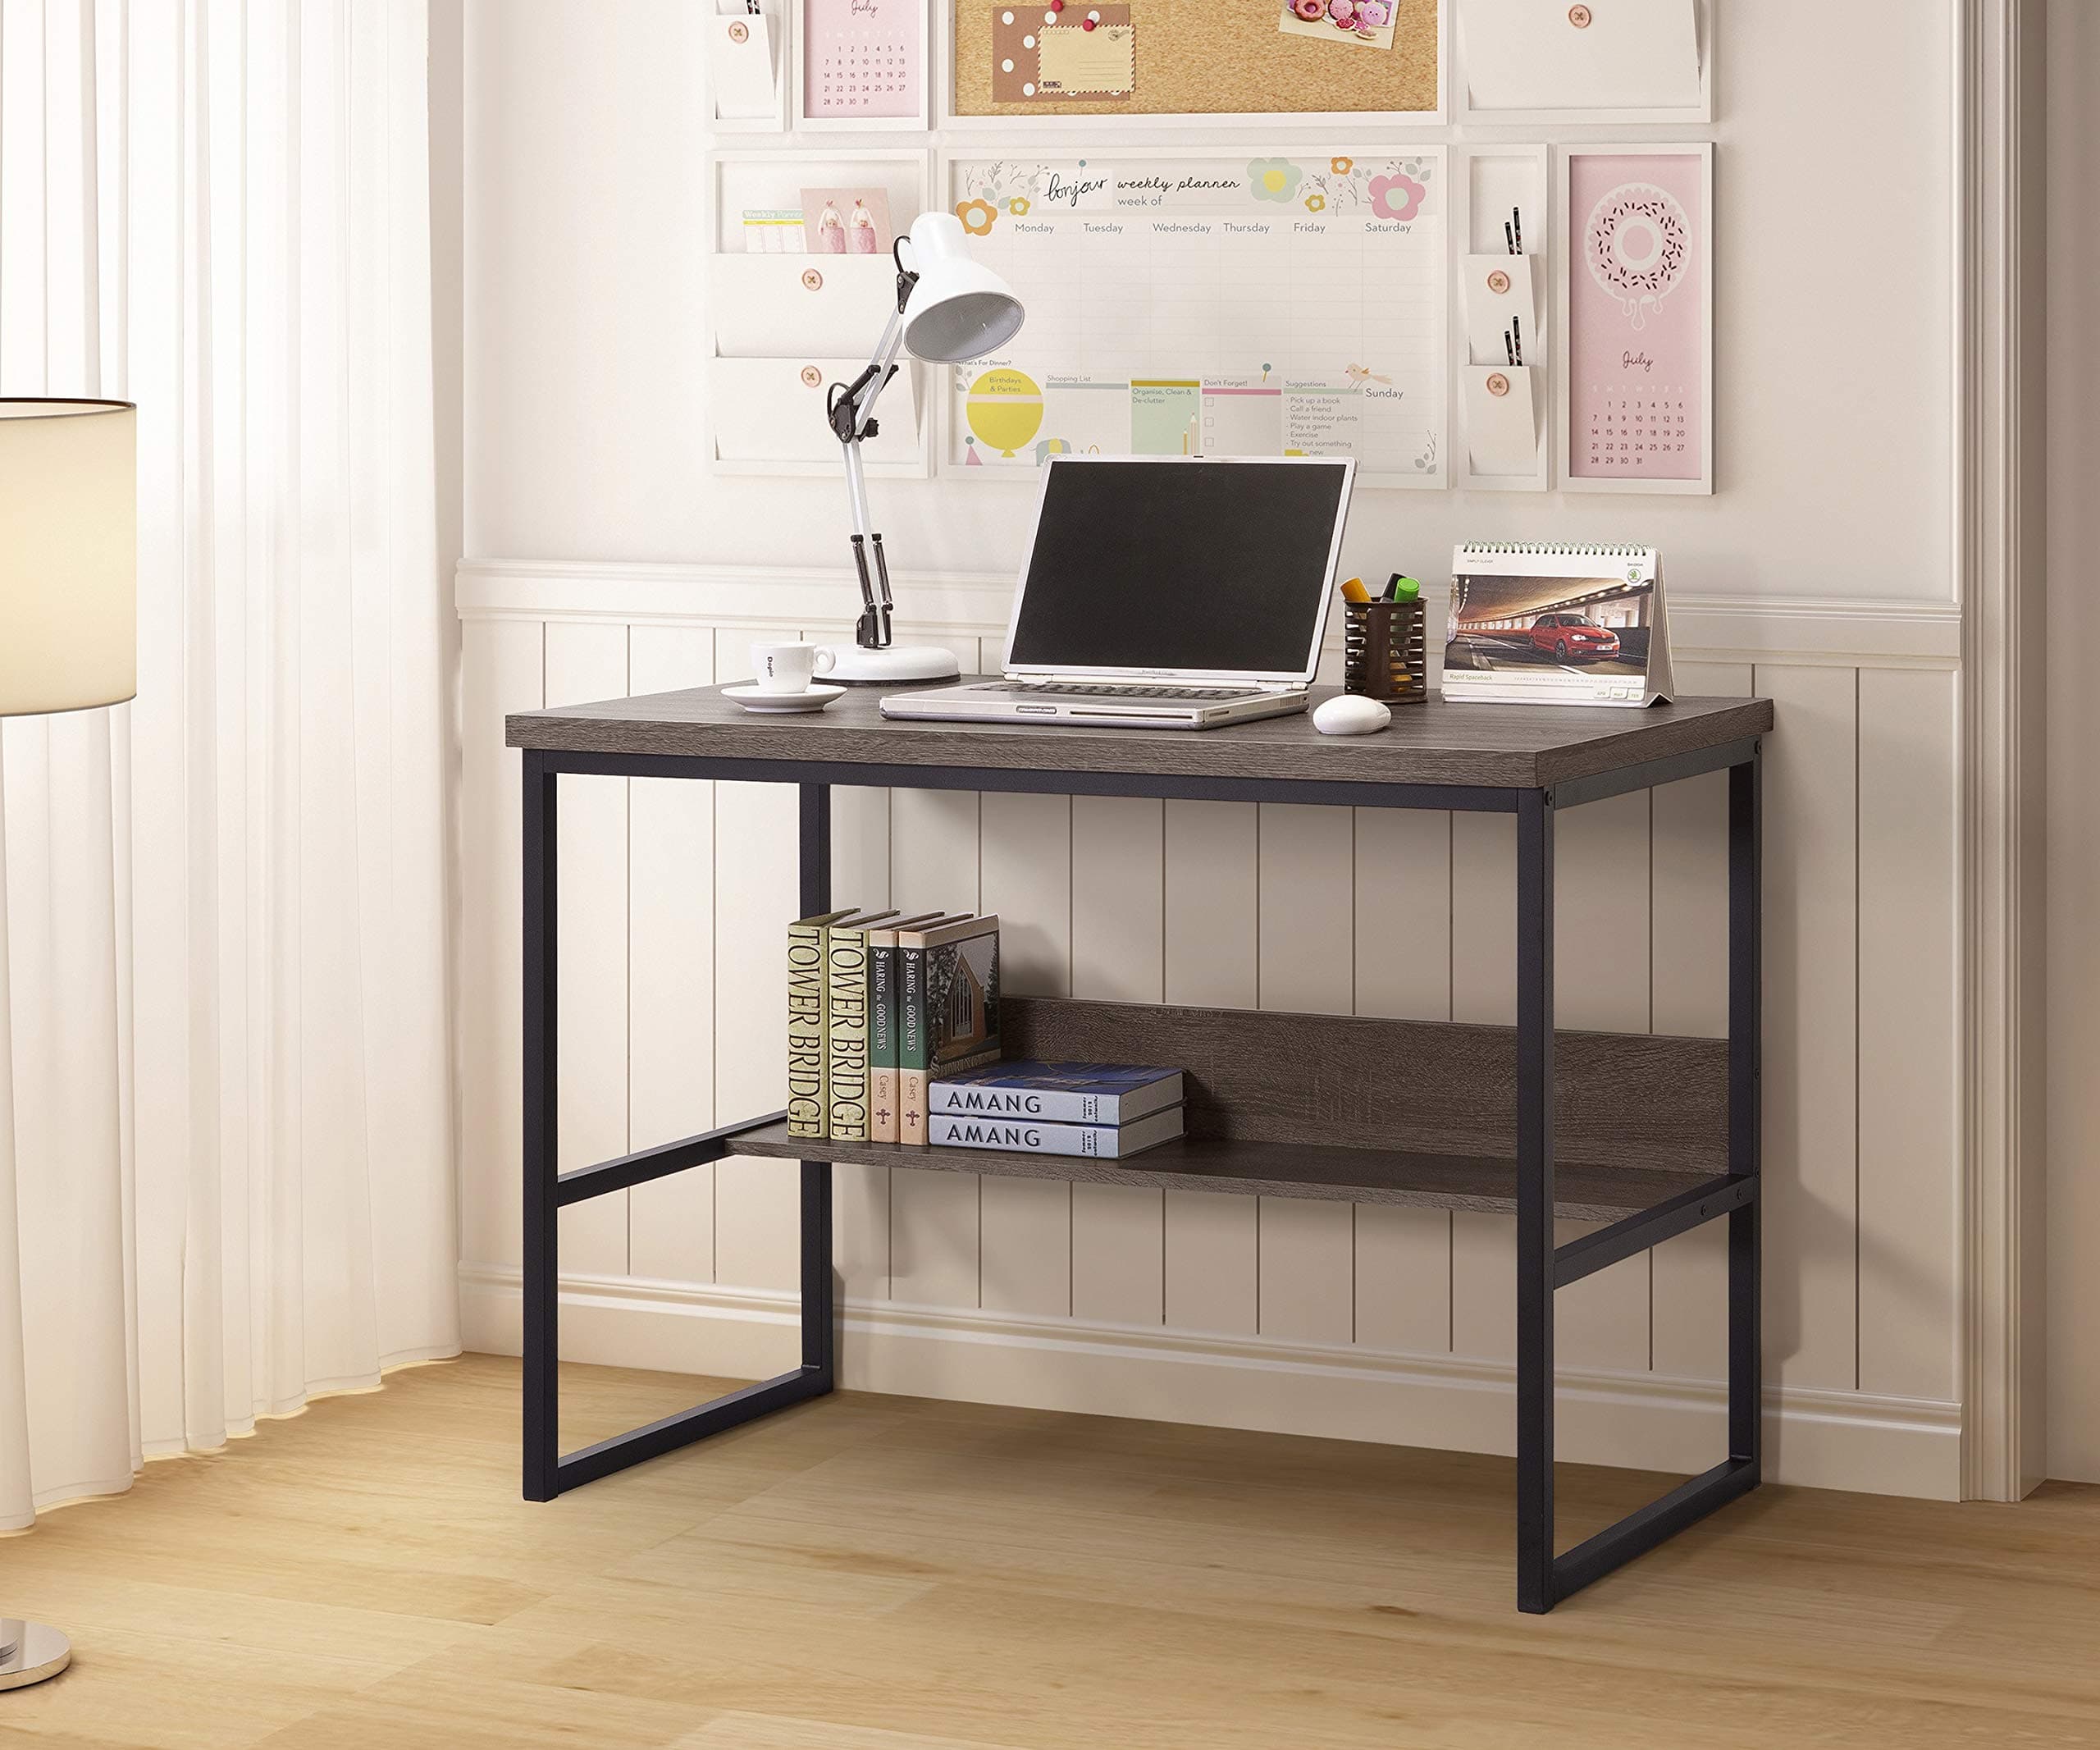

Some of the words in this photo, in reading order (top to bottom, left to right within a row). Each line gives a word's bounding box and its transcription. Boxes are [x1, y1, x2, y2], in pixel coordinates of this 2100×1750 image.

[851, 0, 878, 18] July
[1117, 176, 1173, 192] weekly
[1176, 177, 1241, 192] planner
[1117, 195, 1148, 206] week
[1149, 195, 1162, 206] of
[1015, 223, 1055, 235] Monday
[1084, 223, 1124, 235] Tuesday
[1153, 223, 1212, 235] Wednesday
[1223, 223, 1271, 235] Thursday
[1294, 223, 1326, 235] Friday
[1365, 223, 1412, 235] Saturday
[1623, 350, 1654, 372] July
[989, 377, 1021, 385] Birthdays
[1048, 375, 1078, 383] Shopping
[1285, 380, 1326, 388] Suggestions
[1366, 388, 1404, 400] Sunday
[1622, 400, 1627, 409] 2
[1664, 401, 1669, 409] 5
[1635, 414, 1643, 423] 10
[1663, 415, 1670, 423] 12
[1290, 423, 1304, 431] Play
[1606, 428, 1614, 436] 15
[1620, 428, 1628, 436] 16
[1636, 428, 1642, 436] 17
[1291, 440, 1300, 448] Try
[1316, 441, 1352, 449] something
[1591, 442, 1599, 450] 21
[1605, 442, 1614, 450] 22
[1649, 443, 1658, 451] 25
[1663, 443, 1671, 451] 26
[1605, 456, 1614, 464] 29
[1466, 674, 1492, 682] Spaceback
[788, 929, 821, 1026] TOWER
[829, 931, 865, 1032] TOWER
[876, 1003, 887, 1029] GOOD
[906, 1005, 916, 1030] GOOD
[877, 1030, 888, 1050] NEWS
[907, 1030, 917, 1052] NEWS
[788, 1035, 821, 1134] BRIDGE
[830, 1037, 865, 1138] BRIDGE
[877, 1075, 889, 1100] Casey
[908, 1076, 920, 1102] Casey
[947, 1091, 1042, 1113] AMANG
[947, 1124, 1041, 1147] AMANG
